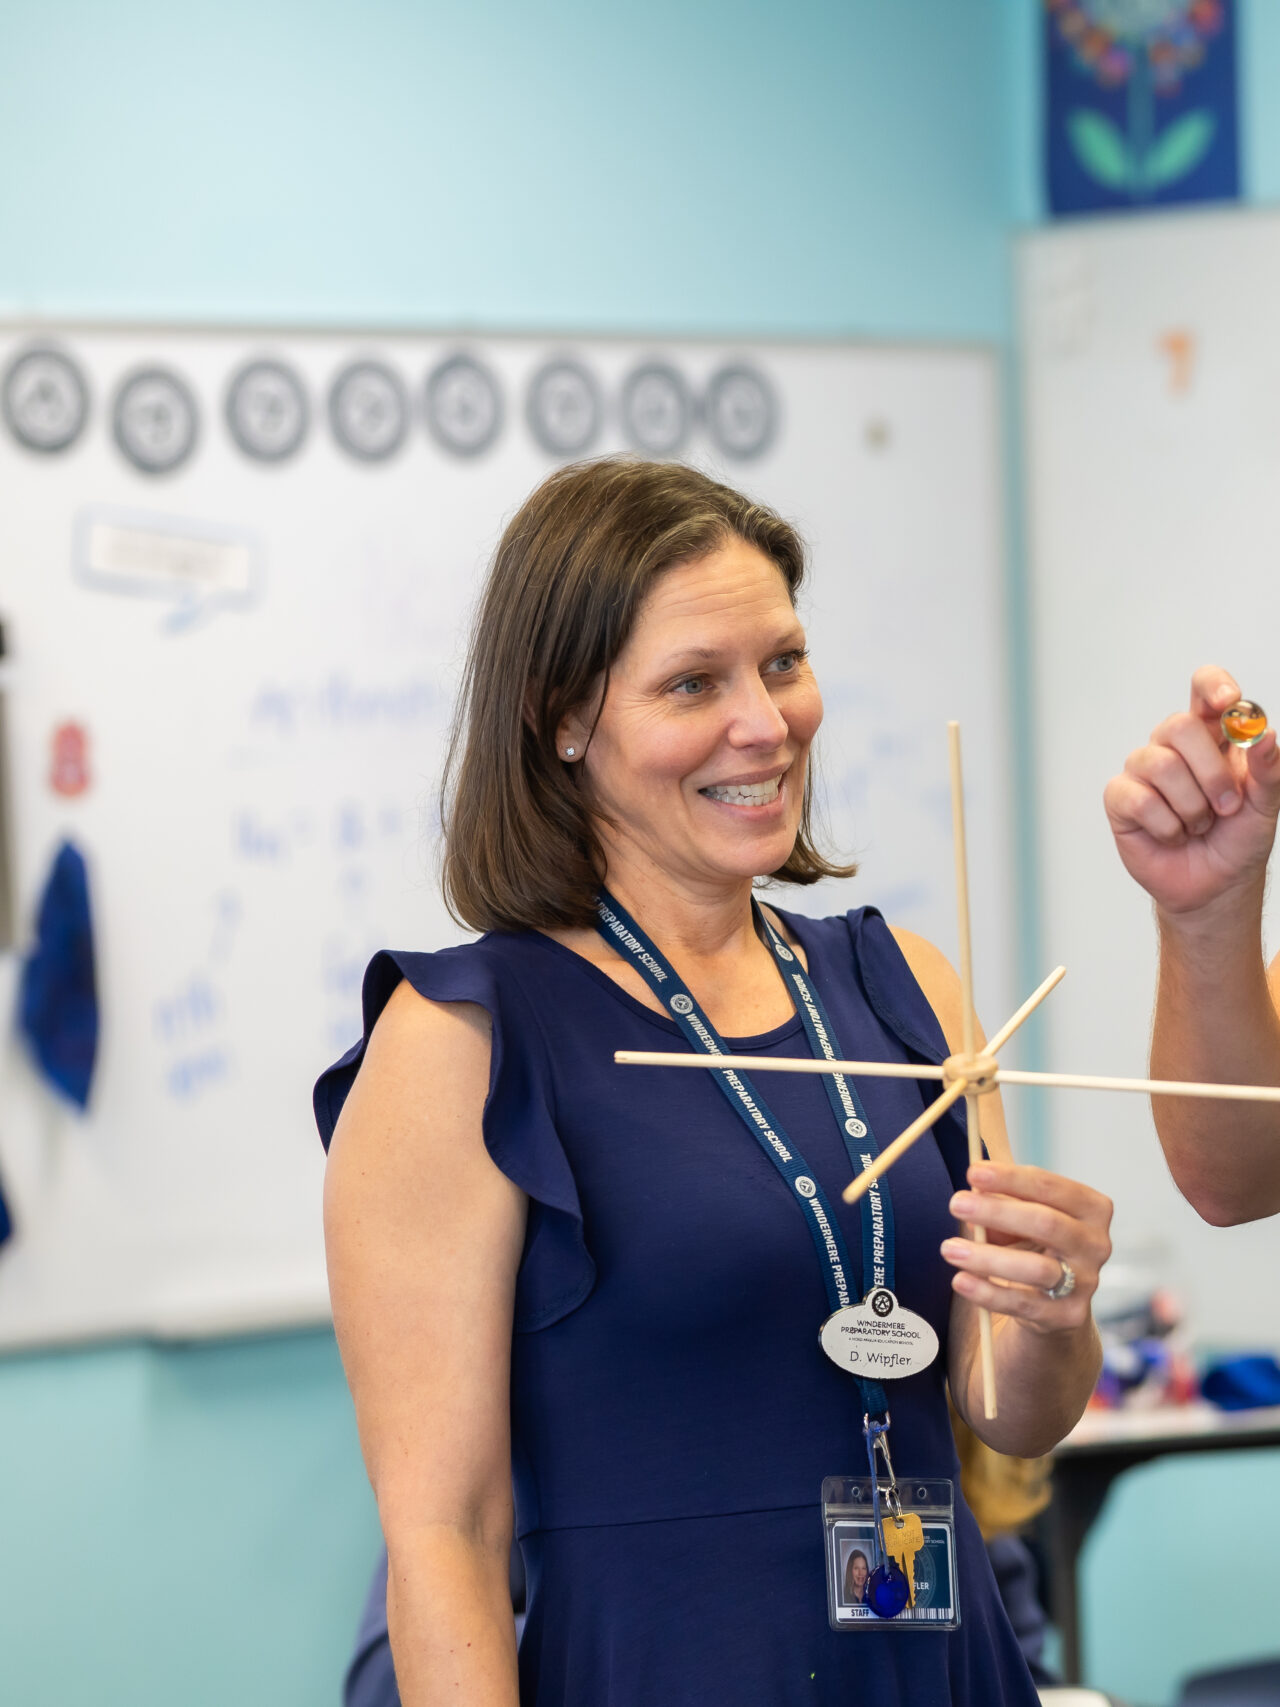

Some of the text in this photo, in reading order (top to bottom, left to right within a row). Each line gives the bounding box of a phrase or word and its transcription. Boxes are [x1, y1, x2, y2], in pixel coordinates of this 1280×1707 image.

[637, 952, 668, 984] SCHOOL
[685, 1013, 793, 1163] WINDERM PREPARATORY SCHOOL
[832, 1071, 857, 1118] WINDERME
[868, 1189, 885, 1264] PREPARATORY
[808, 1197, 850, 1307] WINDERMERE PREPAR
[840, 1326, 921, 1339] PREPARATORY SCHOOL
[856, 1320, 906, 1330] WINDERMERE
[849, 1350, 912, 1368] D. Wipfler
[913, 1581, 930, 1590] FLER
[850, 1608, 869, 1617] STAFF
